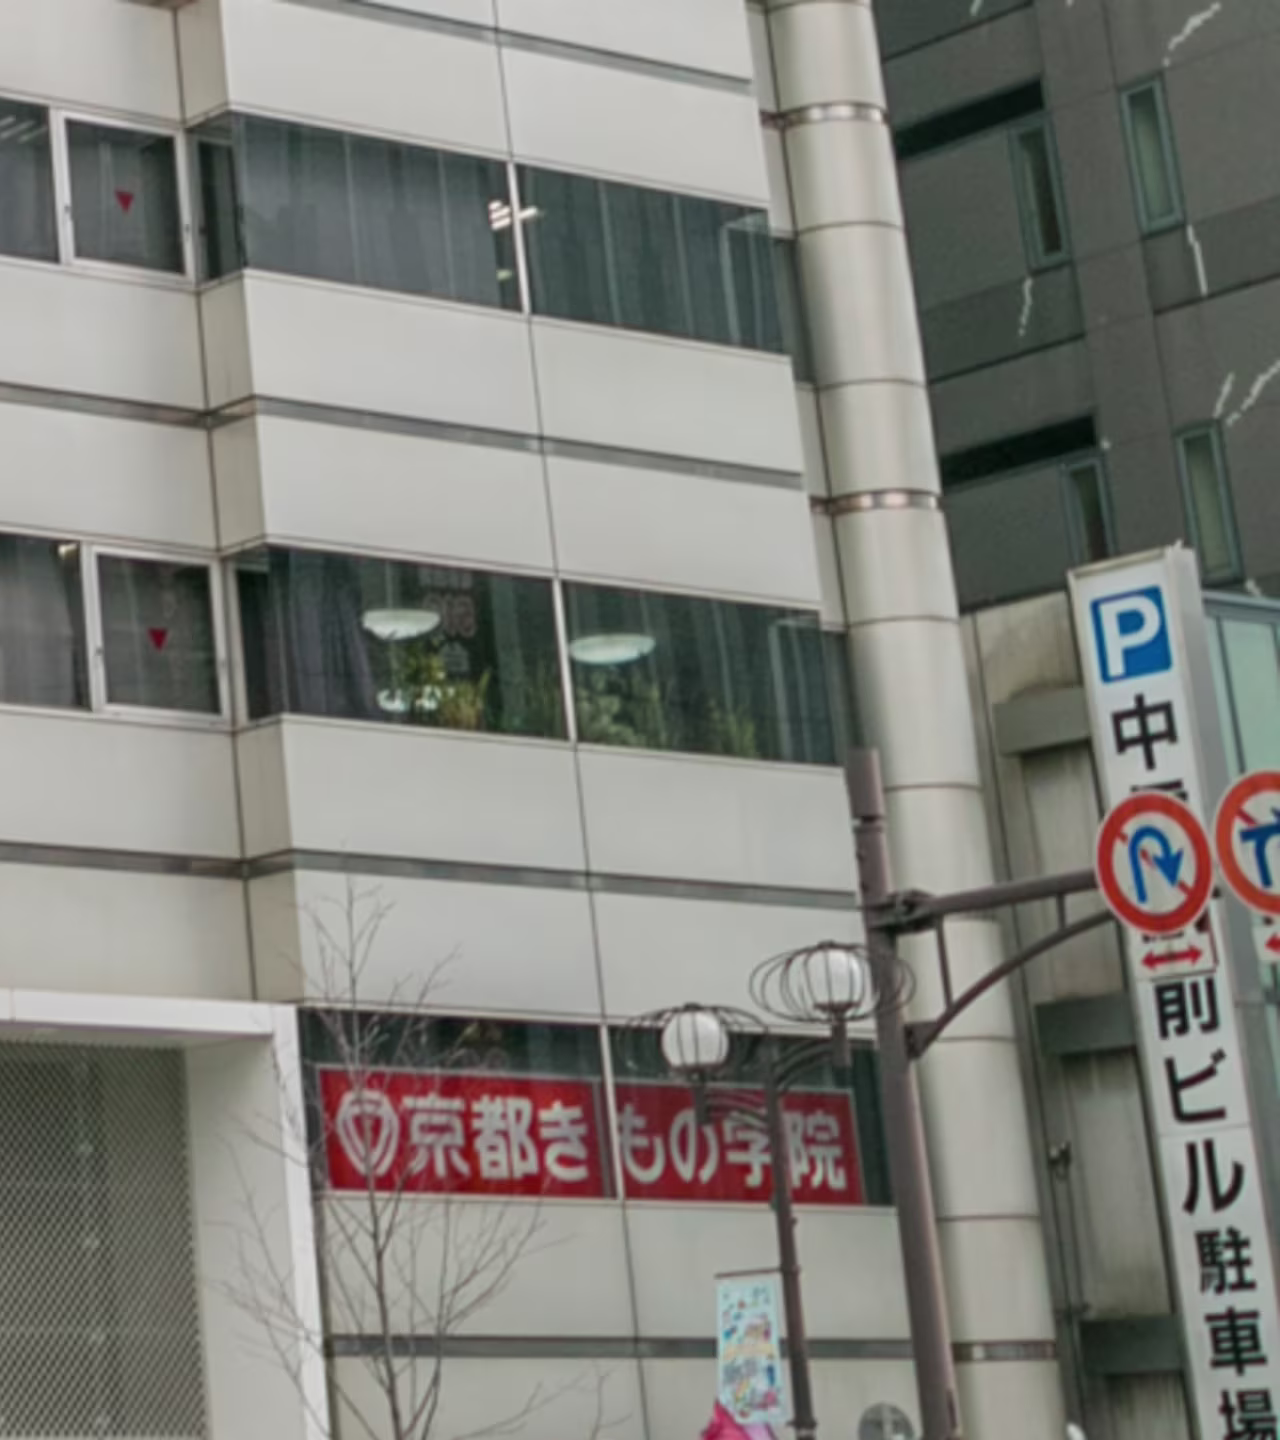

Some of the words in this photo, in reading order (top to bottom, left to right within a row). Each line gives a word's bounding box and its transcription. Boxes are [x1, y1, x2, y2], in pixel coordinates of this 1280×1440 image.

[1098, 595, 1162, 678] P
[401, 1092, 847, 1190] 京都きもの学院
